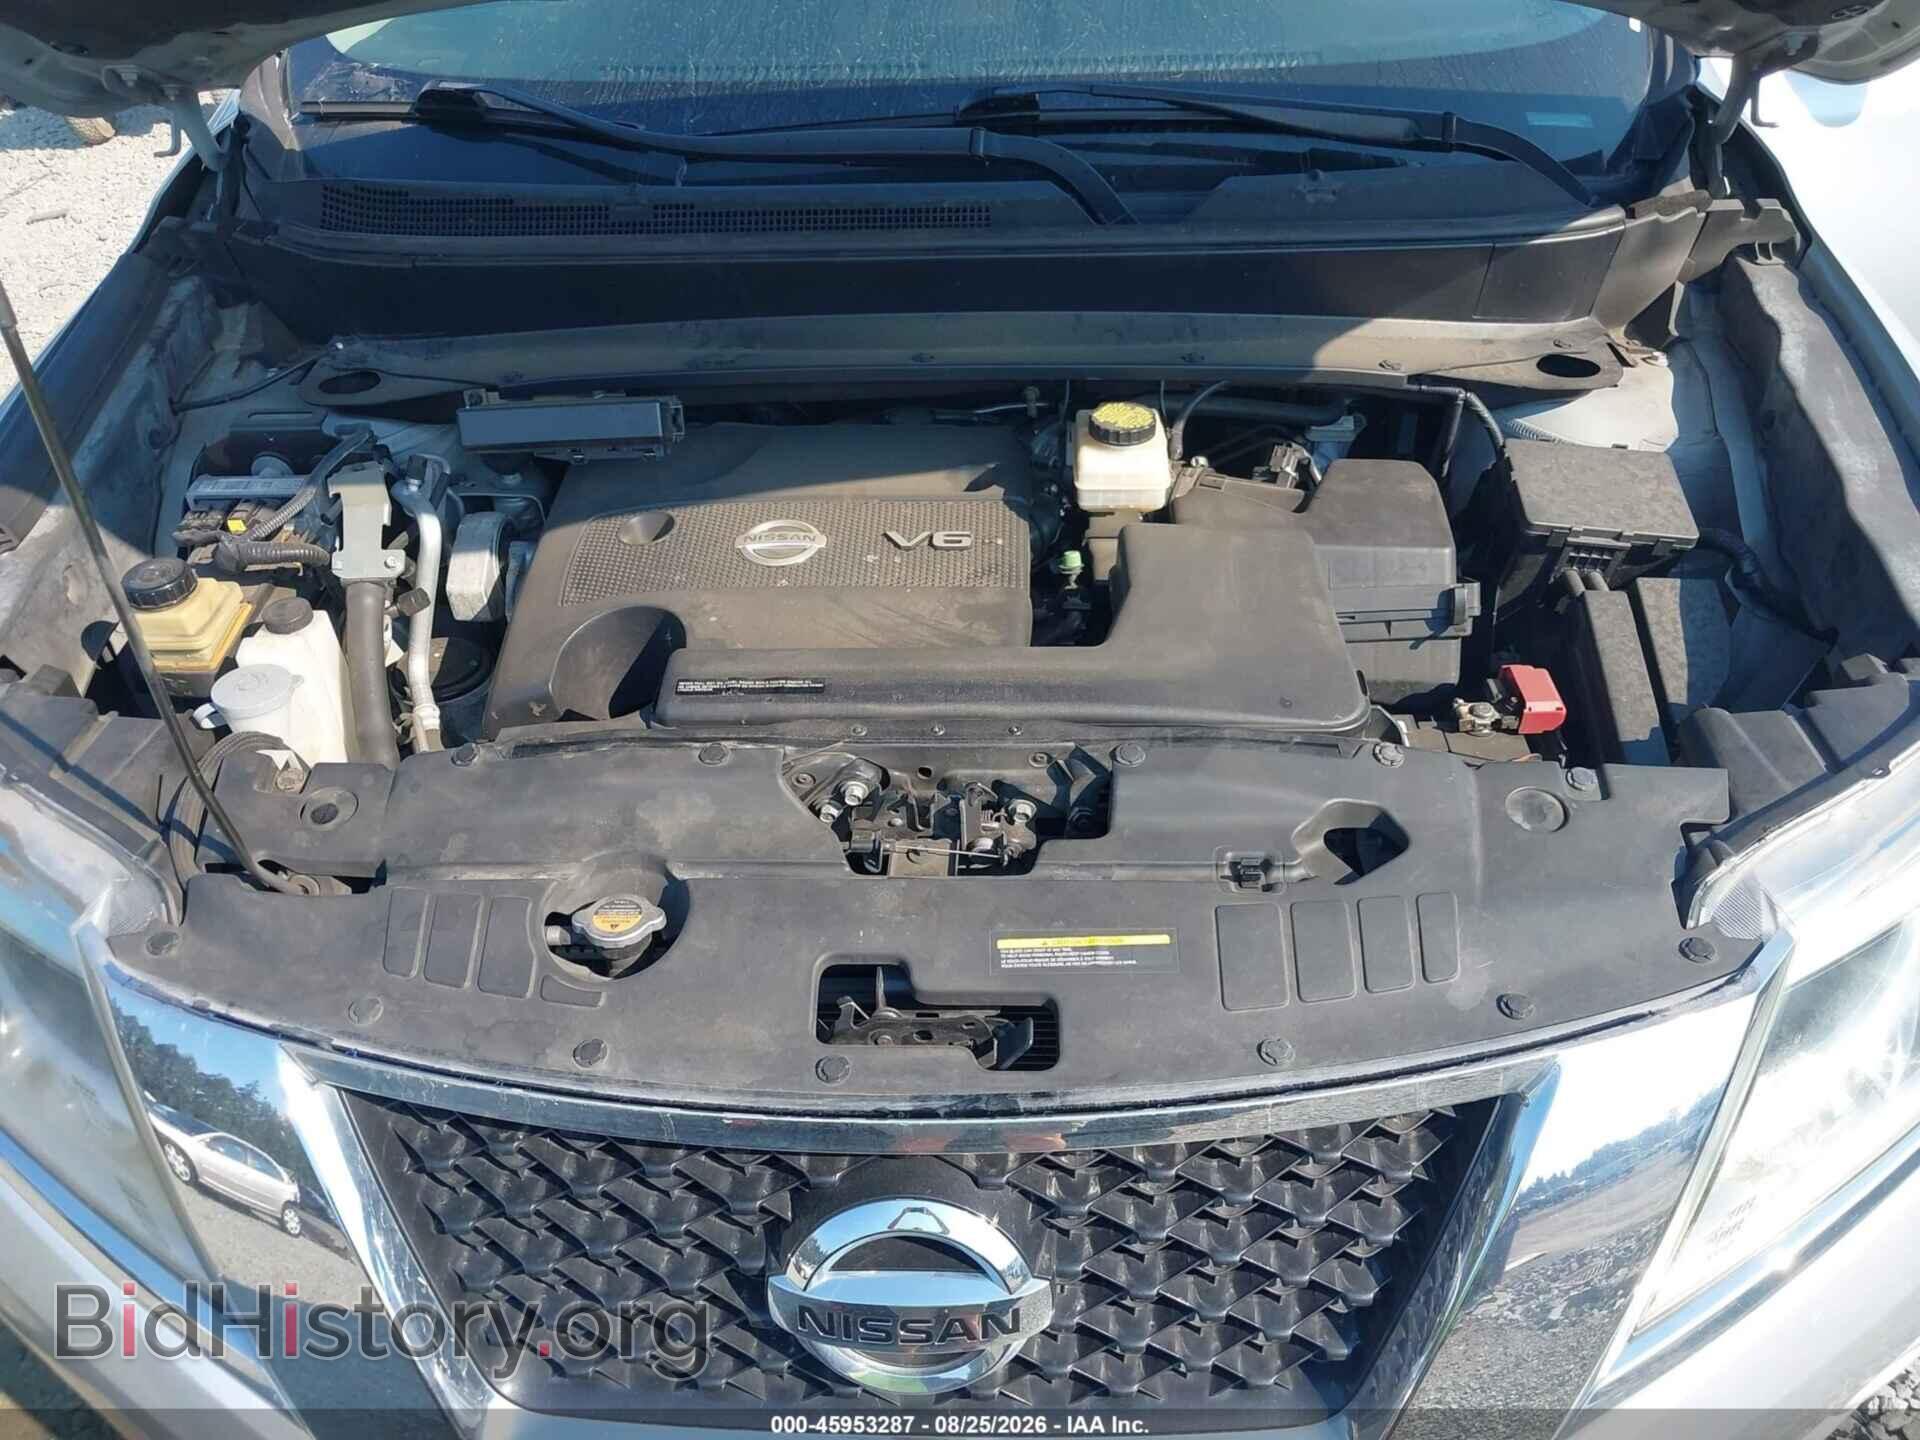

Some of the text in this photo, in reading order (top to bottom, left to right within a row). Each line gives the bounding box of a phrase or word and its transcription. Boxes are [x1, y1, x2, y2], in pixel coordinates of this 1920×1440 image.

[743, 534, 816, 543] NISSAN
[883, 530, 972, 551] V6
[797, 1306, 1020, 1345] NISSAN
